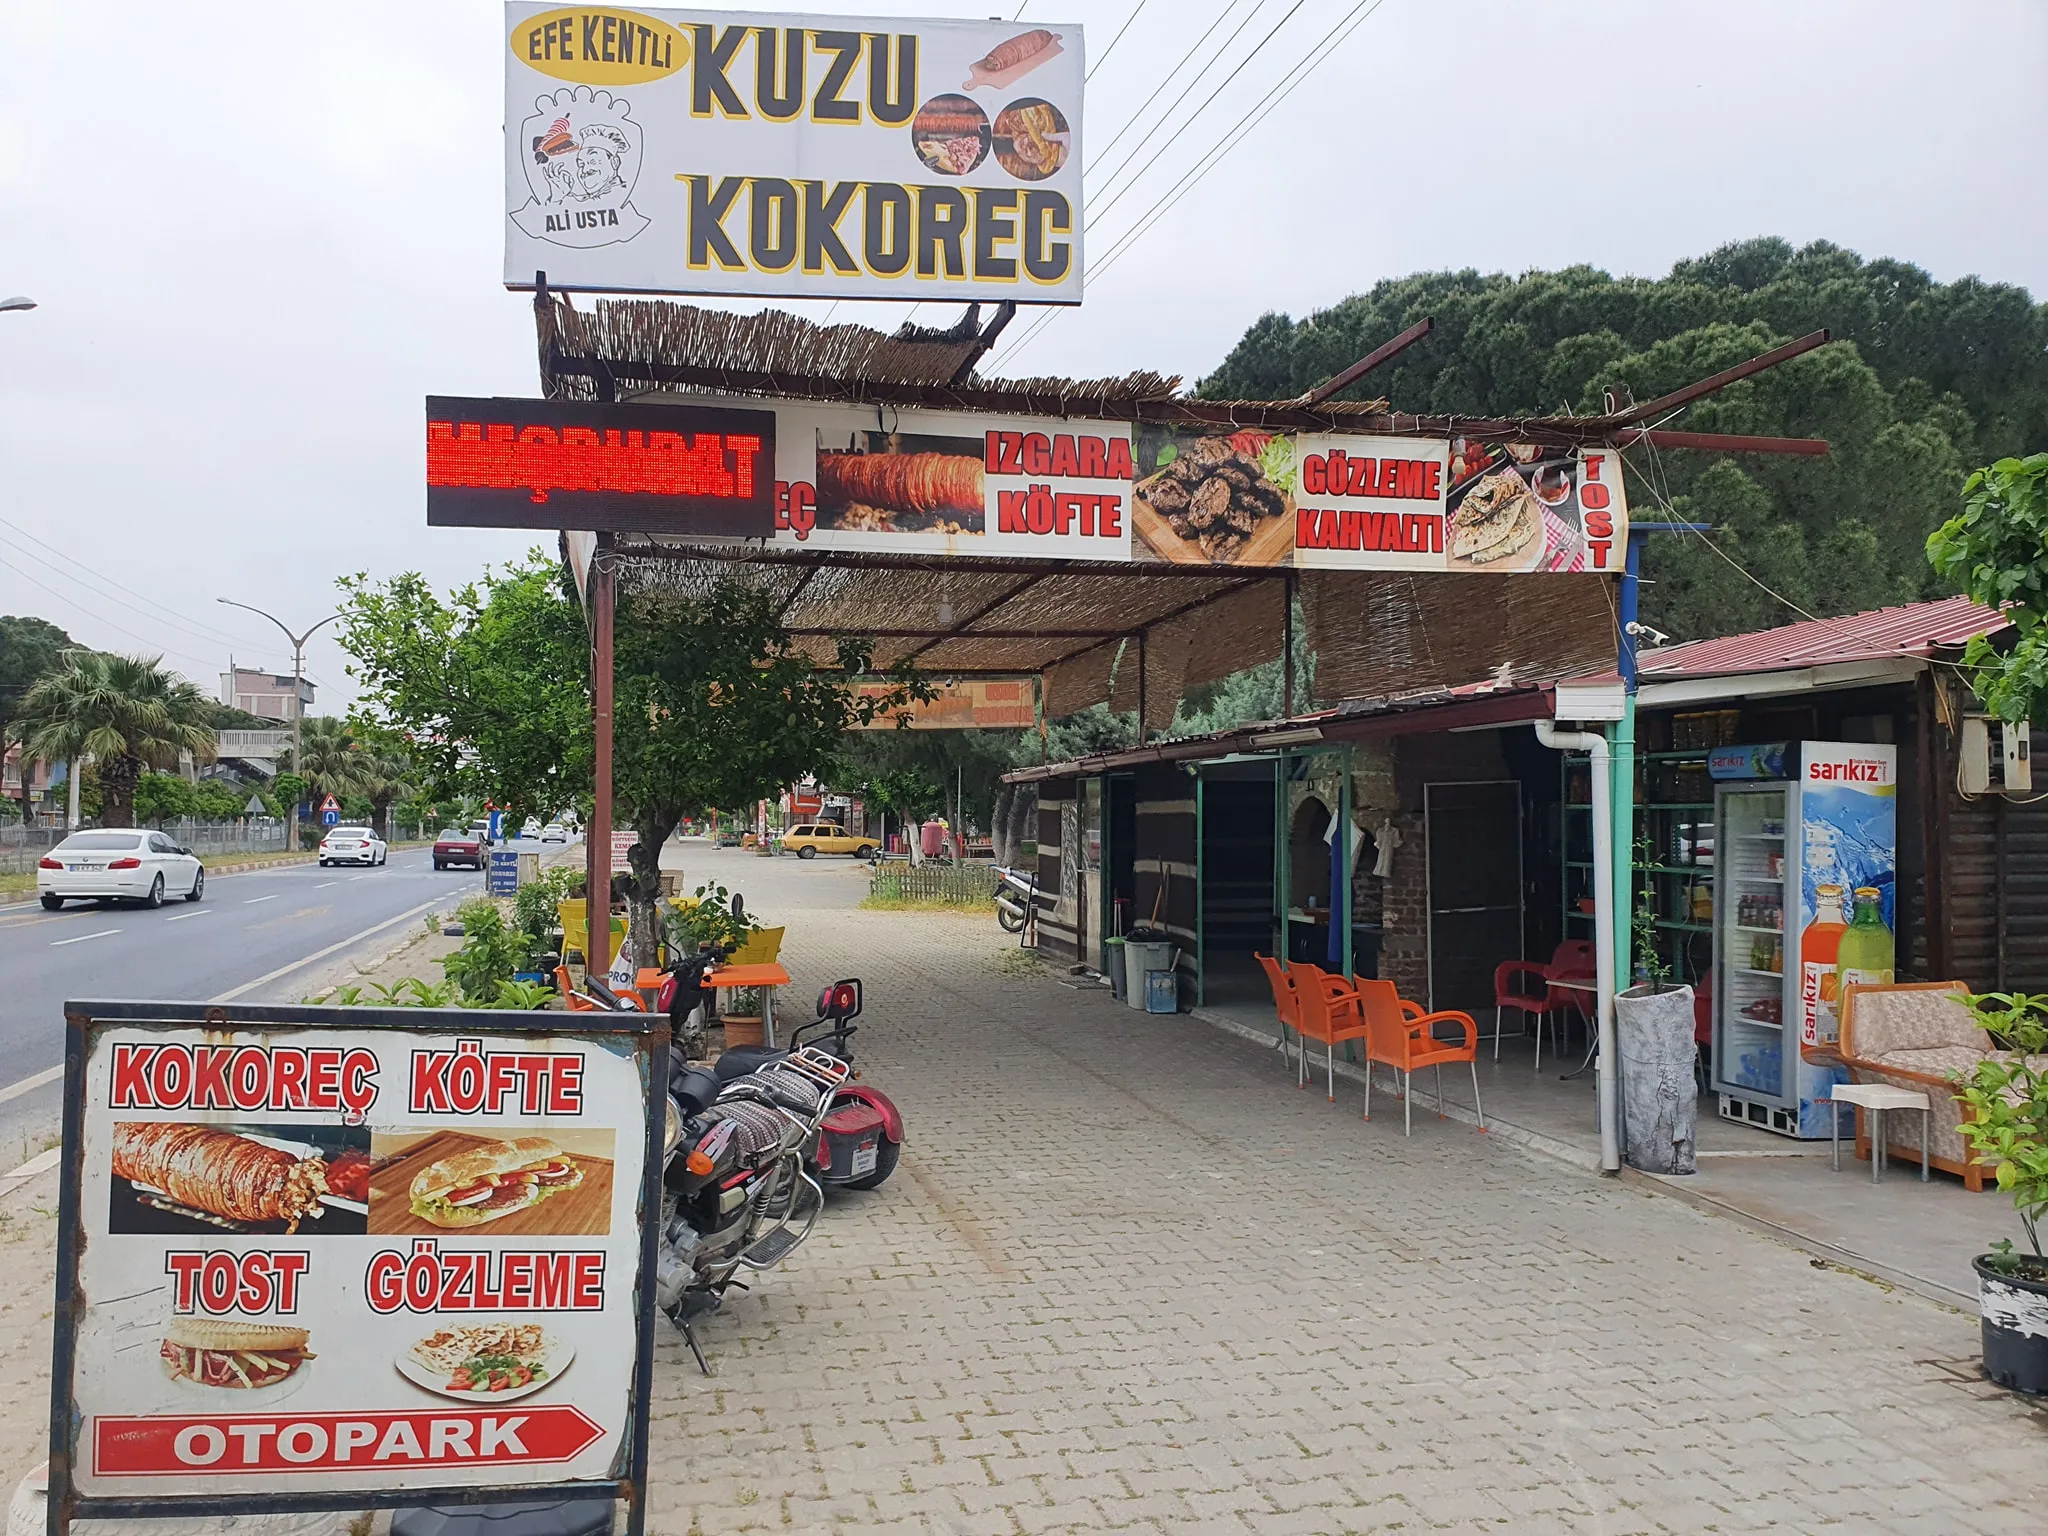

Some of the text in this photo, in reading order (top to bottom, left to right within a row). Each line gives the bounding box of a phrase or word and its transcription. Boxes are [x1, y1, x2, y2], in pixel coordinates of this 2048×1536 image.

[529, 15, 672, 69] EFE KENTLİ
[678, 22, 920, 129] KUZU
[545, 208, 619, 232] ALİ USTA
[674, 173, 1073, 286] KOKOREC
[985, 430, 1132, 480] IZGARA
[1303, 448, 1442, 501] GÖZLEME
[998, 483, 1122, 538] KÖFTE
[1296, 508, 1444, 554] KAHVALTI
[1580, 454, 1613, 568] TOST
[1810, 758, 1879, 781] sarıkız
[109, 1038, 586, 1127] KOKOREÇ KÖFTE
[165, 1238, 607, 1315] TOST GÖZLEME
[173, 1416, 530, 1465] OTOPARK
